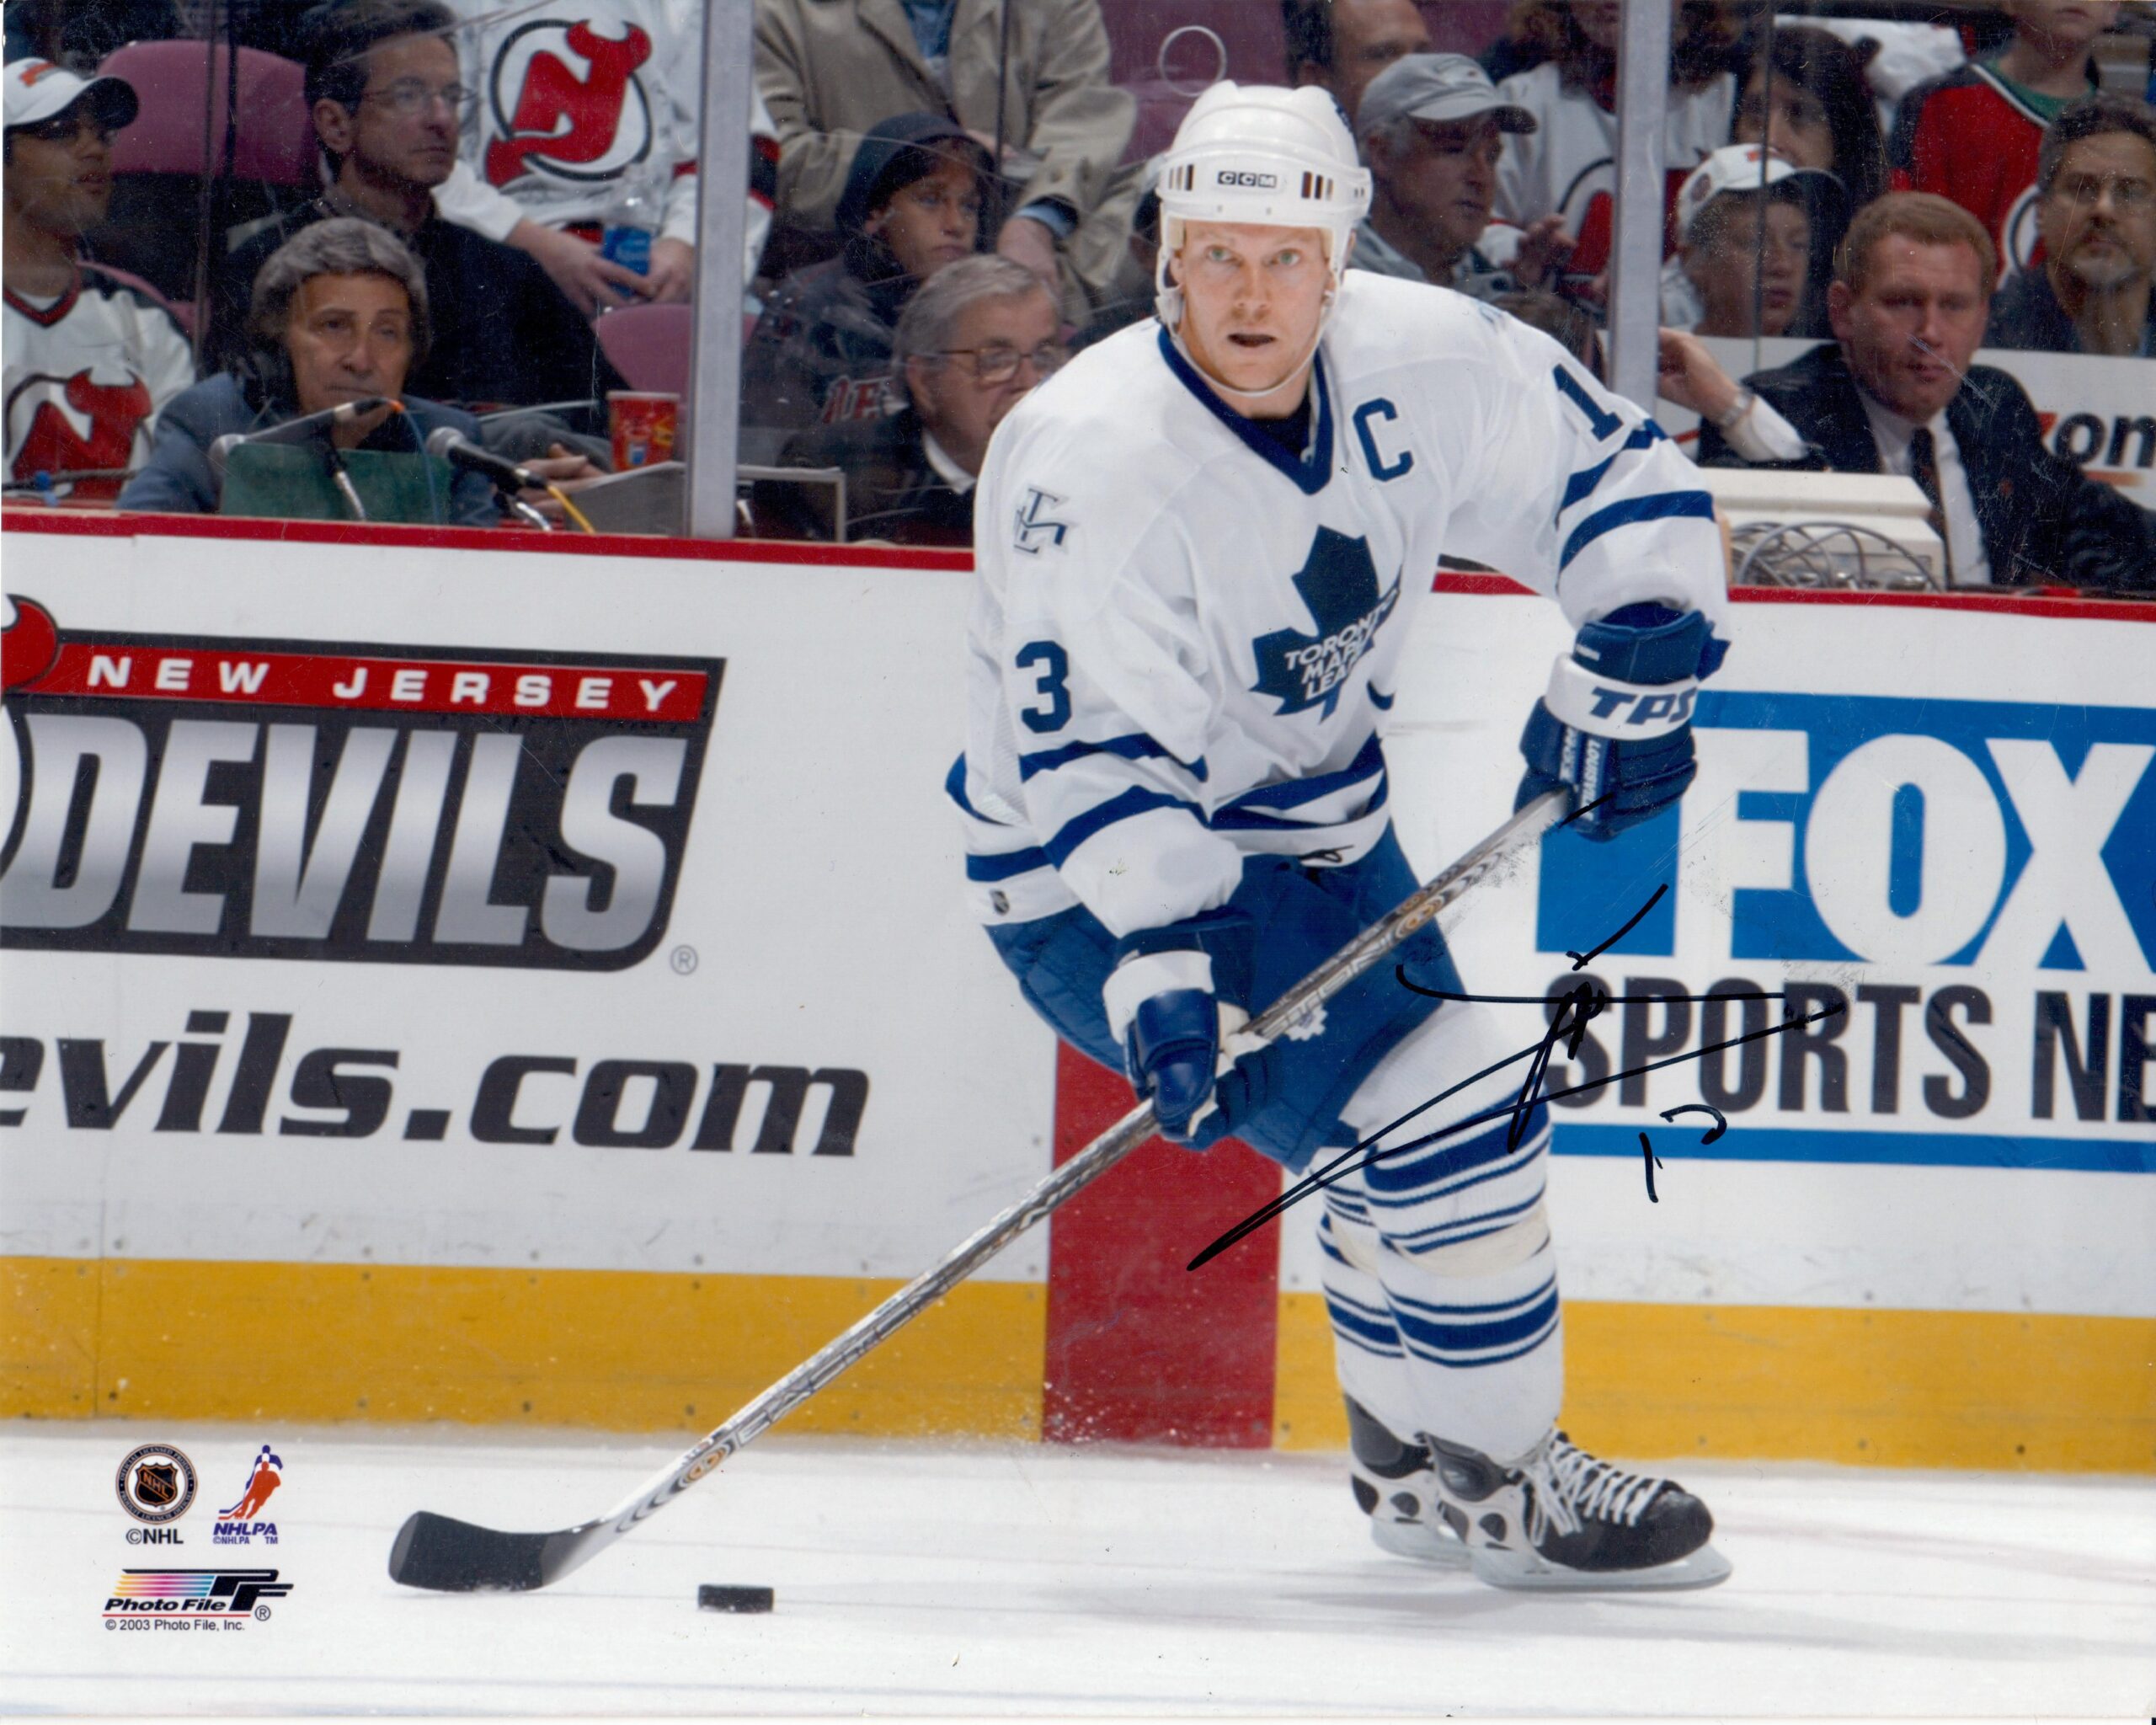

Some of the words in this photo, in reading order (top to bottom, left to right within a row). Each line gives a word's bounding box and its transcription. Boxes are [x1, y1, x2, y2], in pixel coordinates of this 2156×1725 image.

[1218, 170, 1278, 189] CCM
[1353, 398, 1414, 482] C
[1552, 362, 1625, 442] 1
[87, 654, 270, 694] NEW
[333, 667, 677, 712] JERSEY
[1015, 640, 1071, 734] 3
[1301, 636, 1368, 684] MAP
[1305, 657, 1355, 701] LEA
[1590, 686, 1698, 725] TPS
[0, 713, 687, 952] DEVILS
[1674, 726, 2156, 977] FOX
[1540, 973, 1993, 1120] SPORTS
